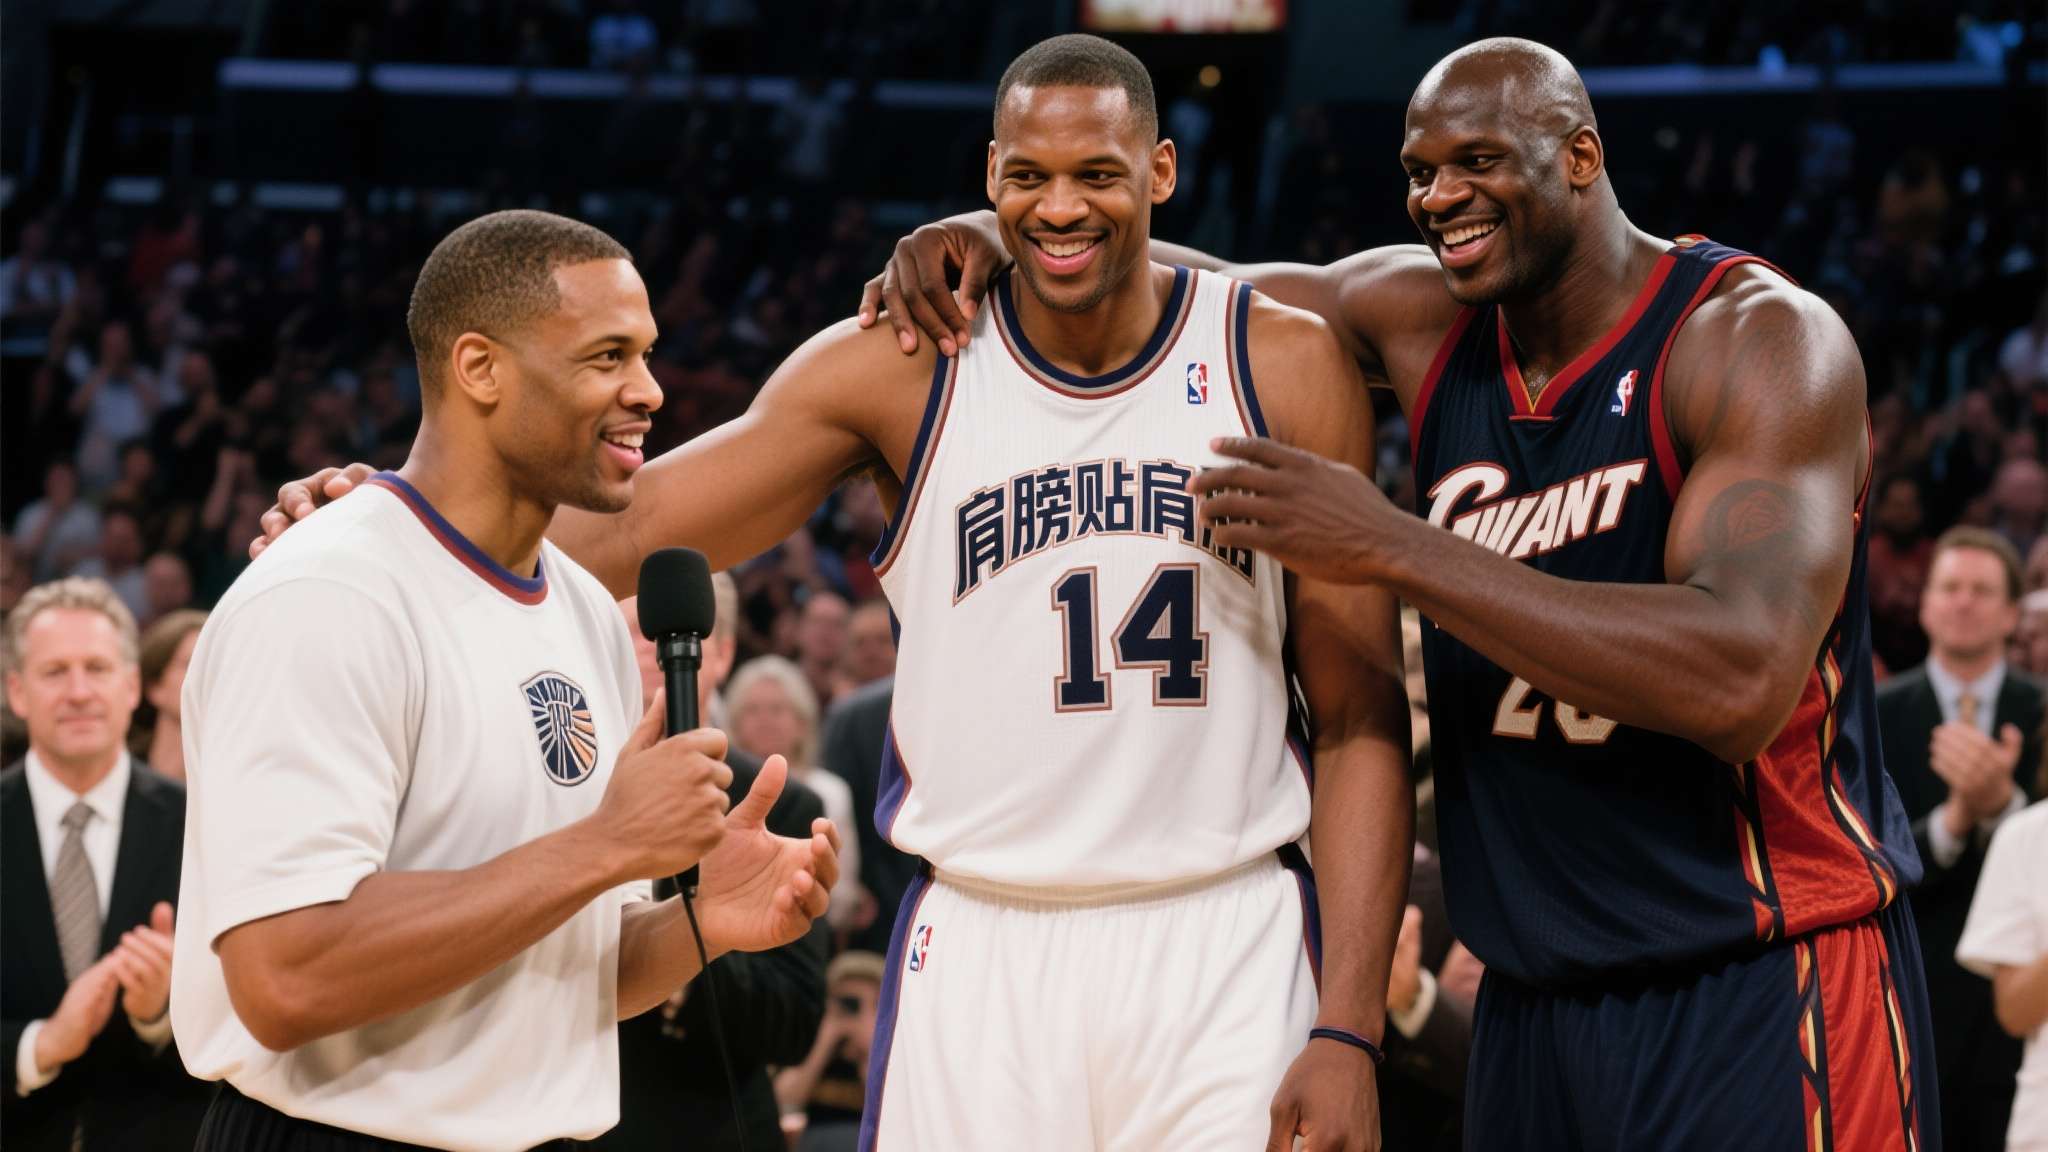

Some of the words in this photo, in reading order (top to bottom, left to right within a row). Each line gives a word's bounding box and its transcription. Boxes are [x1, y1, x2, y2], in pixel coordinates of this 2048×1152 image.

[953, 458, 1256, 607] 肩膀贴肩
[1050, 562, 1210, 713] 14
